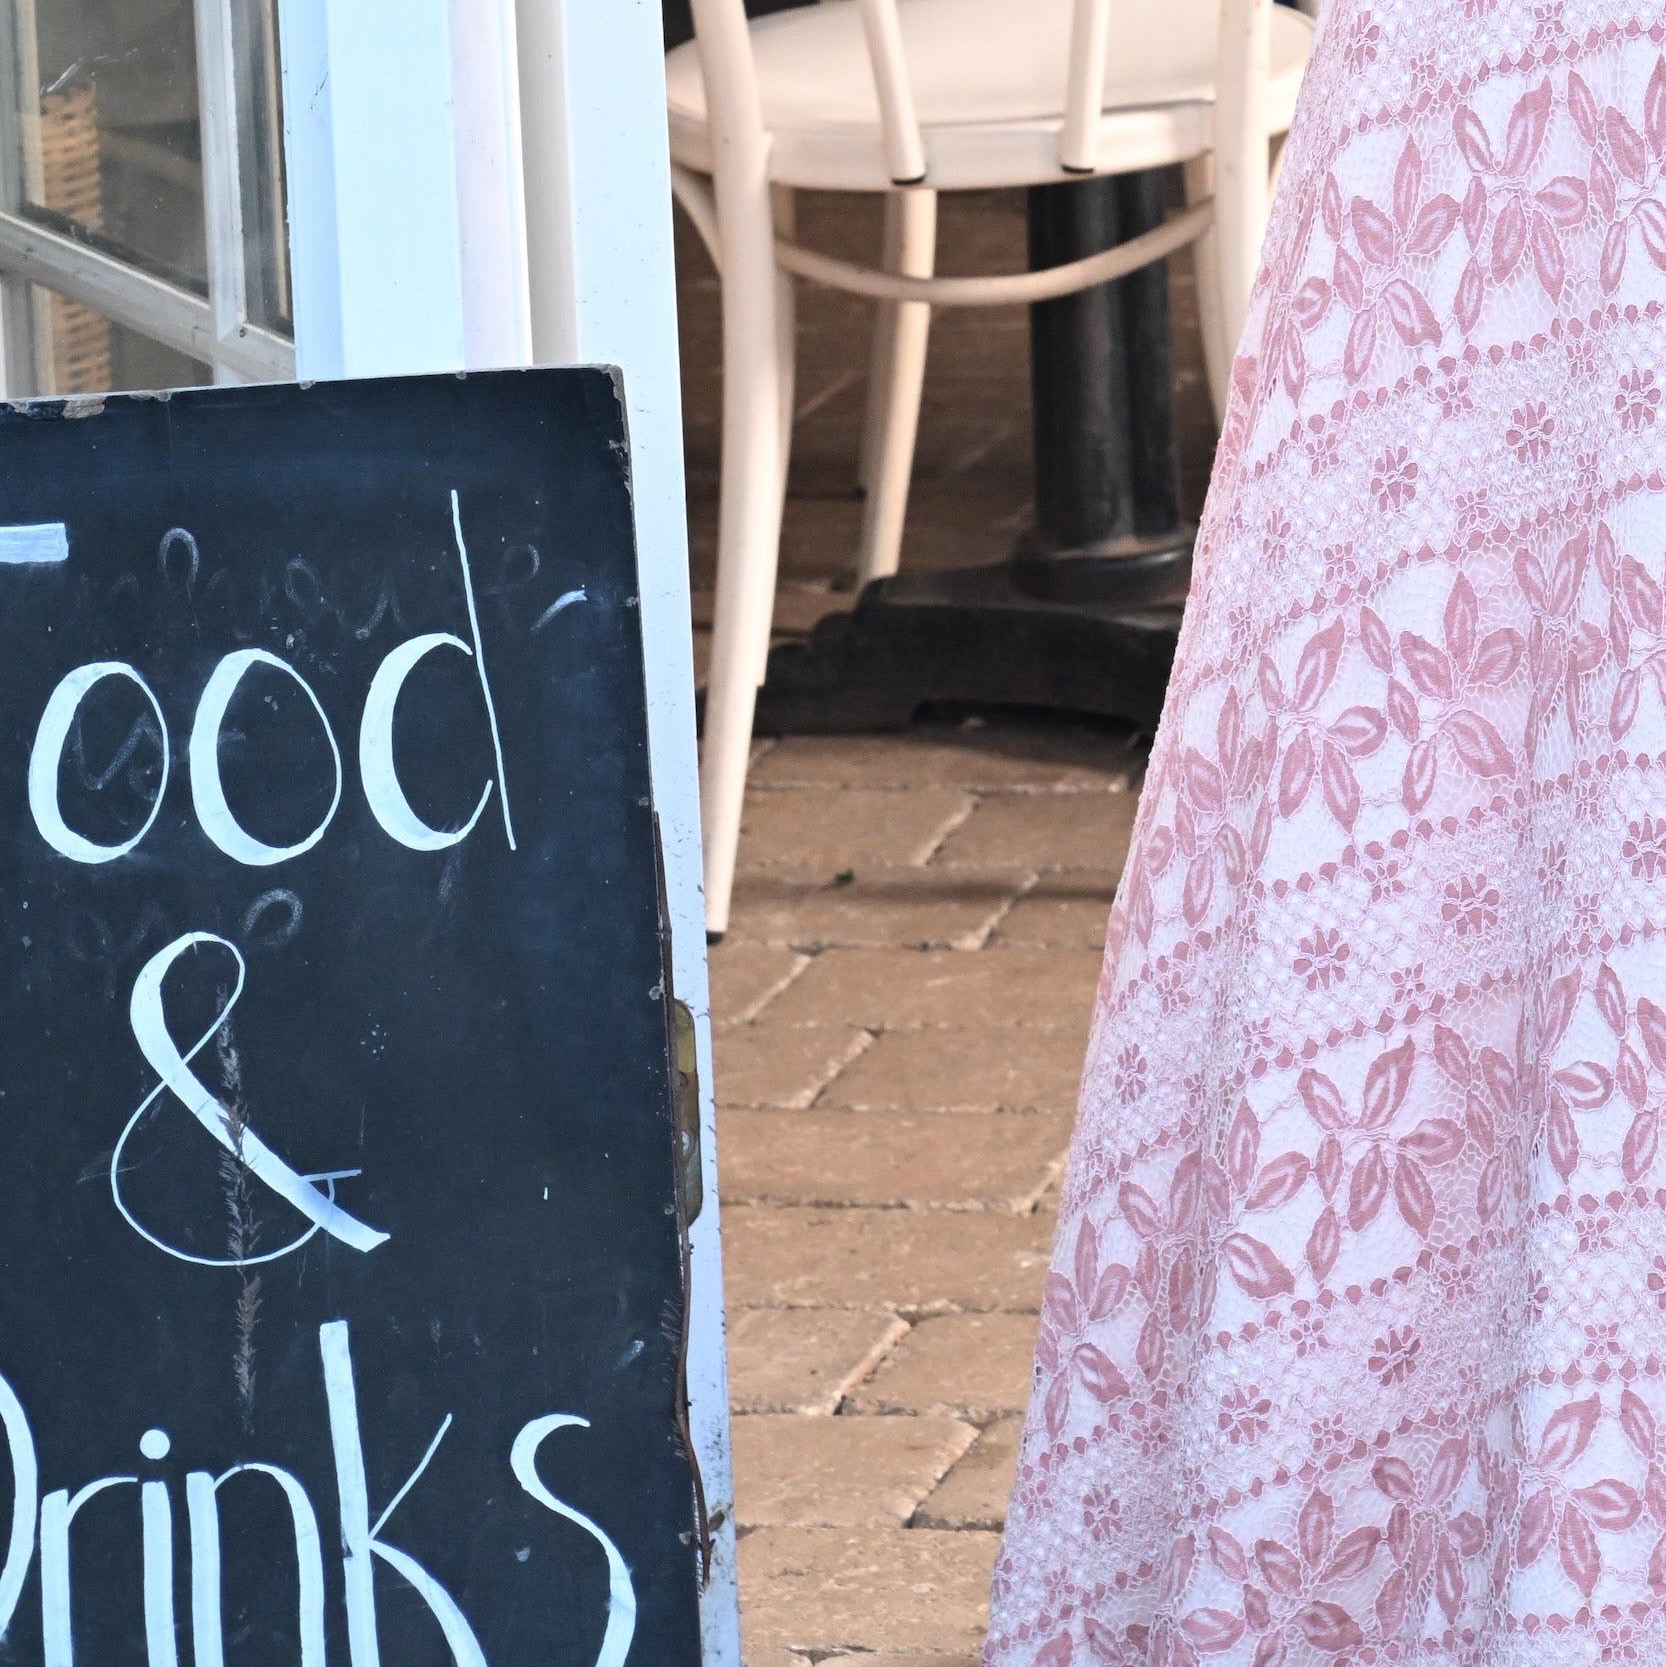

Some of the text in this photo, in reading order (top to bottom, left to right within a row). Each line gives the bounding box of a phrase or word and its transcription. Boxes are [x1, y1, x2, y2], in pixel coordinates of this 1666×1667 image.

[0, 490, 515, 866] ood
[111, 931, 391, 1267] &
[0, 1318, 637, 1667] rinks
